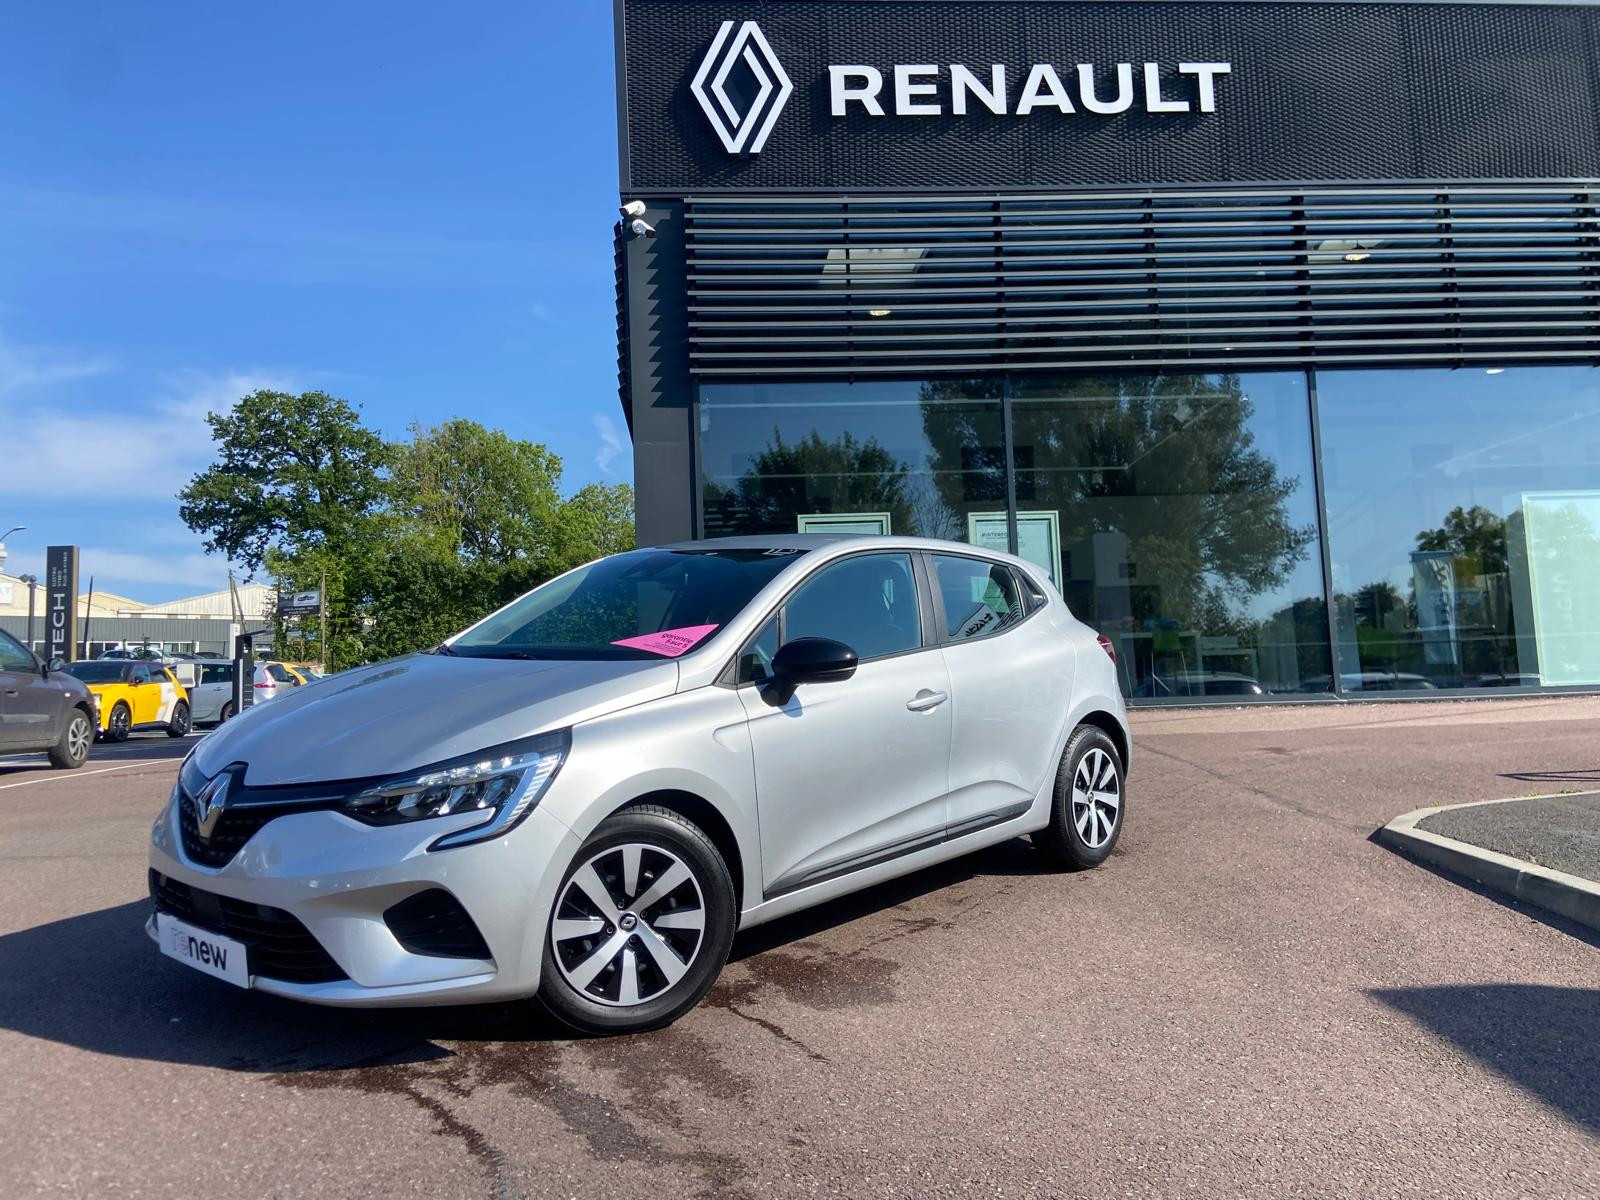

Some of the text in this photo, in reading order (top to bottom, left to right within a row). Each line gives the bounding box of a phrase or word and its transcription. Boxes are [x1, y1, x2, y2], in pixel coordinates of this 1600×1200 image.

[828, 61, 1232, 116] RENAULT
[52, 593, 65, 659] TECH
[661, 633, 694, 644] garantie
